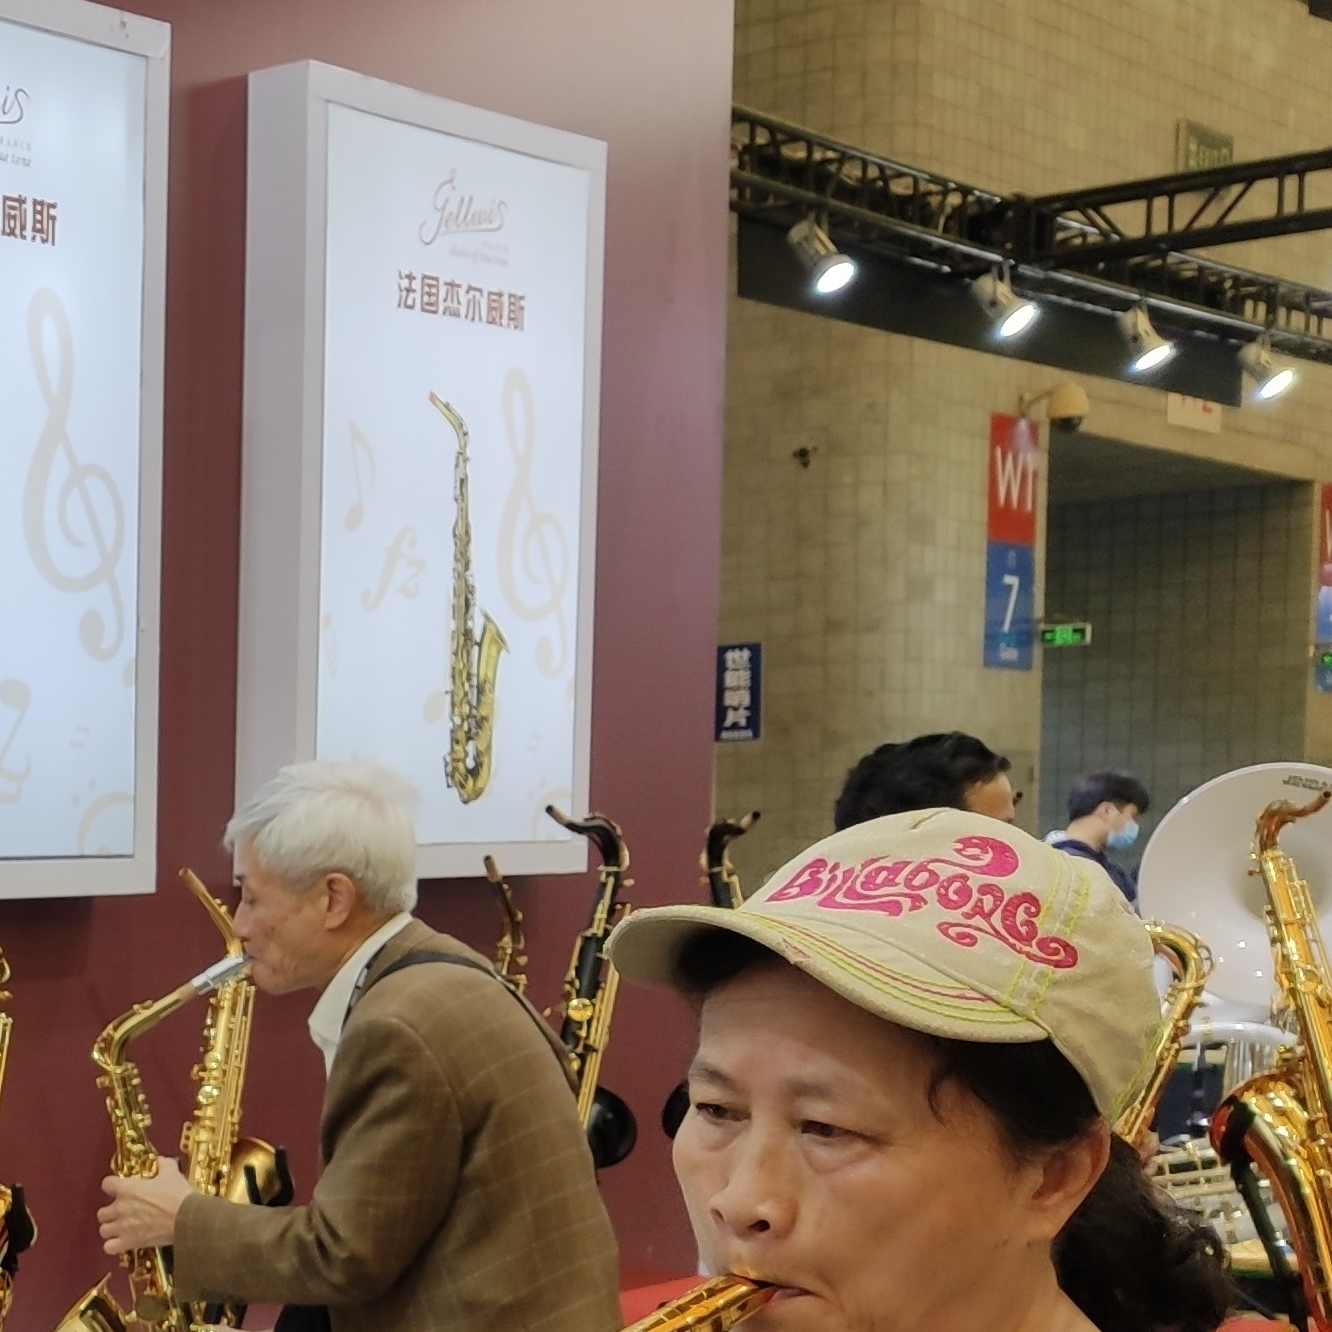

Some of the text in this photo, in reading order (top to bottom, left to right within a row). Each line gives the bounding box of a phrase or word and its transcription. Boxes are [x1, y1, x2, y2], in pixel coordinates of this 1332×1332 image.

[397, 270, 526, 331] 法国杰尔威斯
[996, 445, 1033, 512] W1
[1002, 574, 1020, 634] 7
